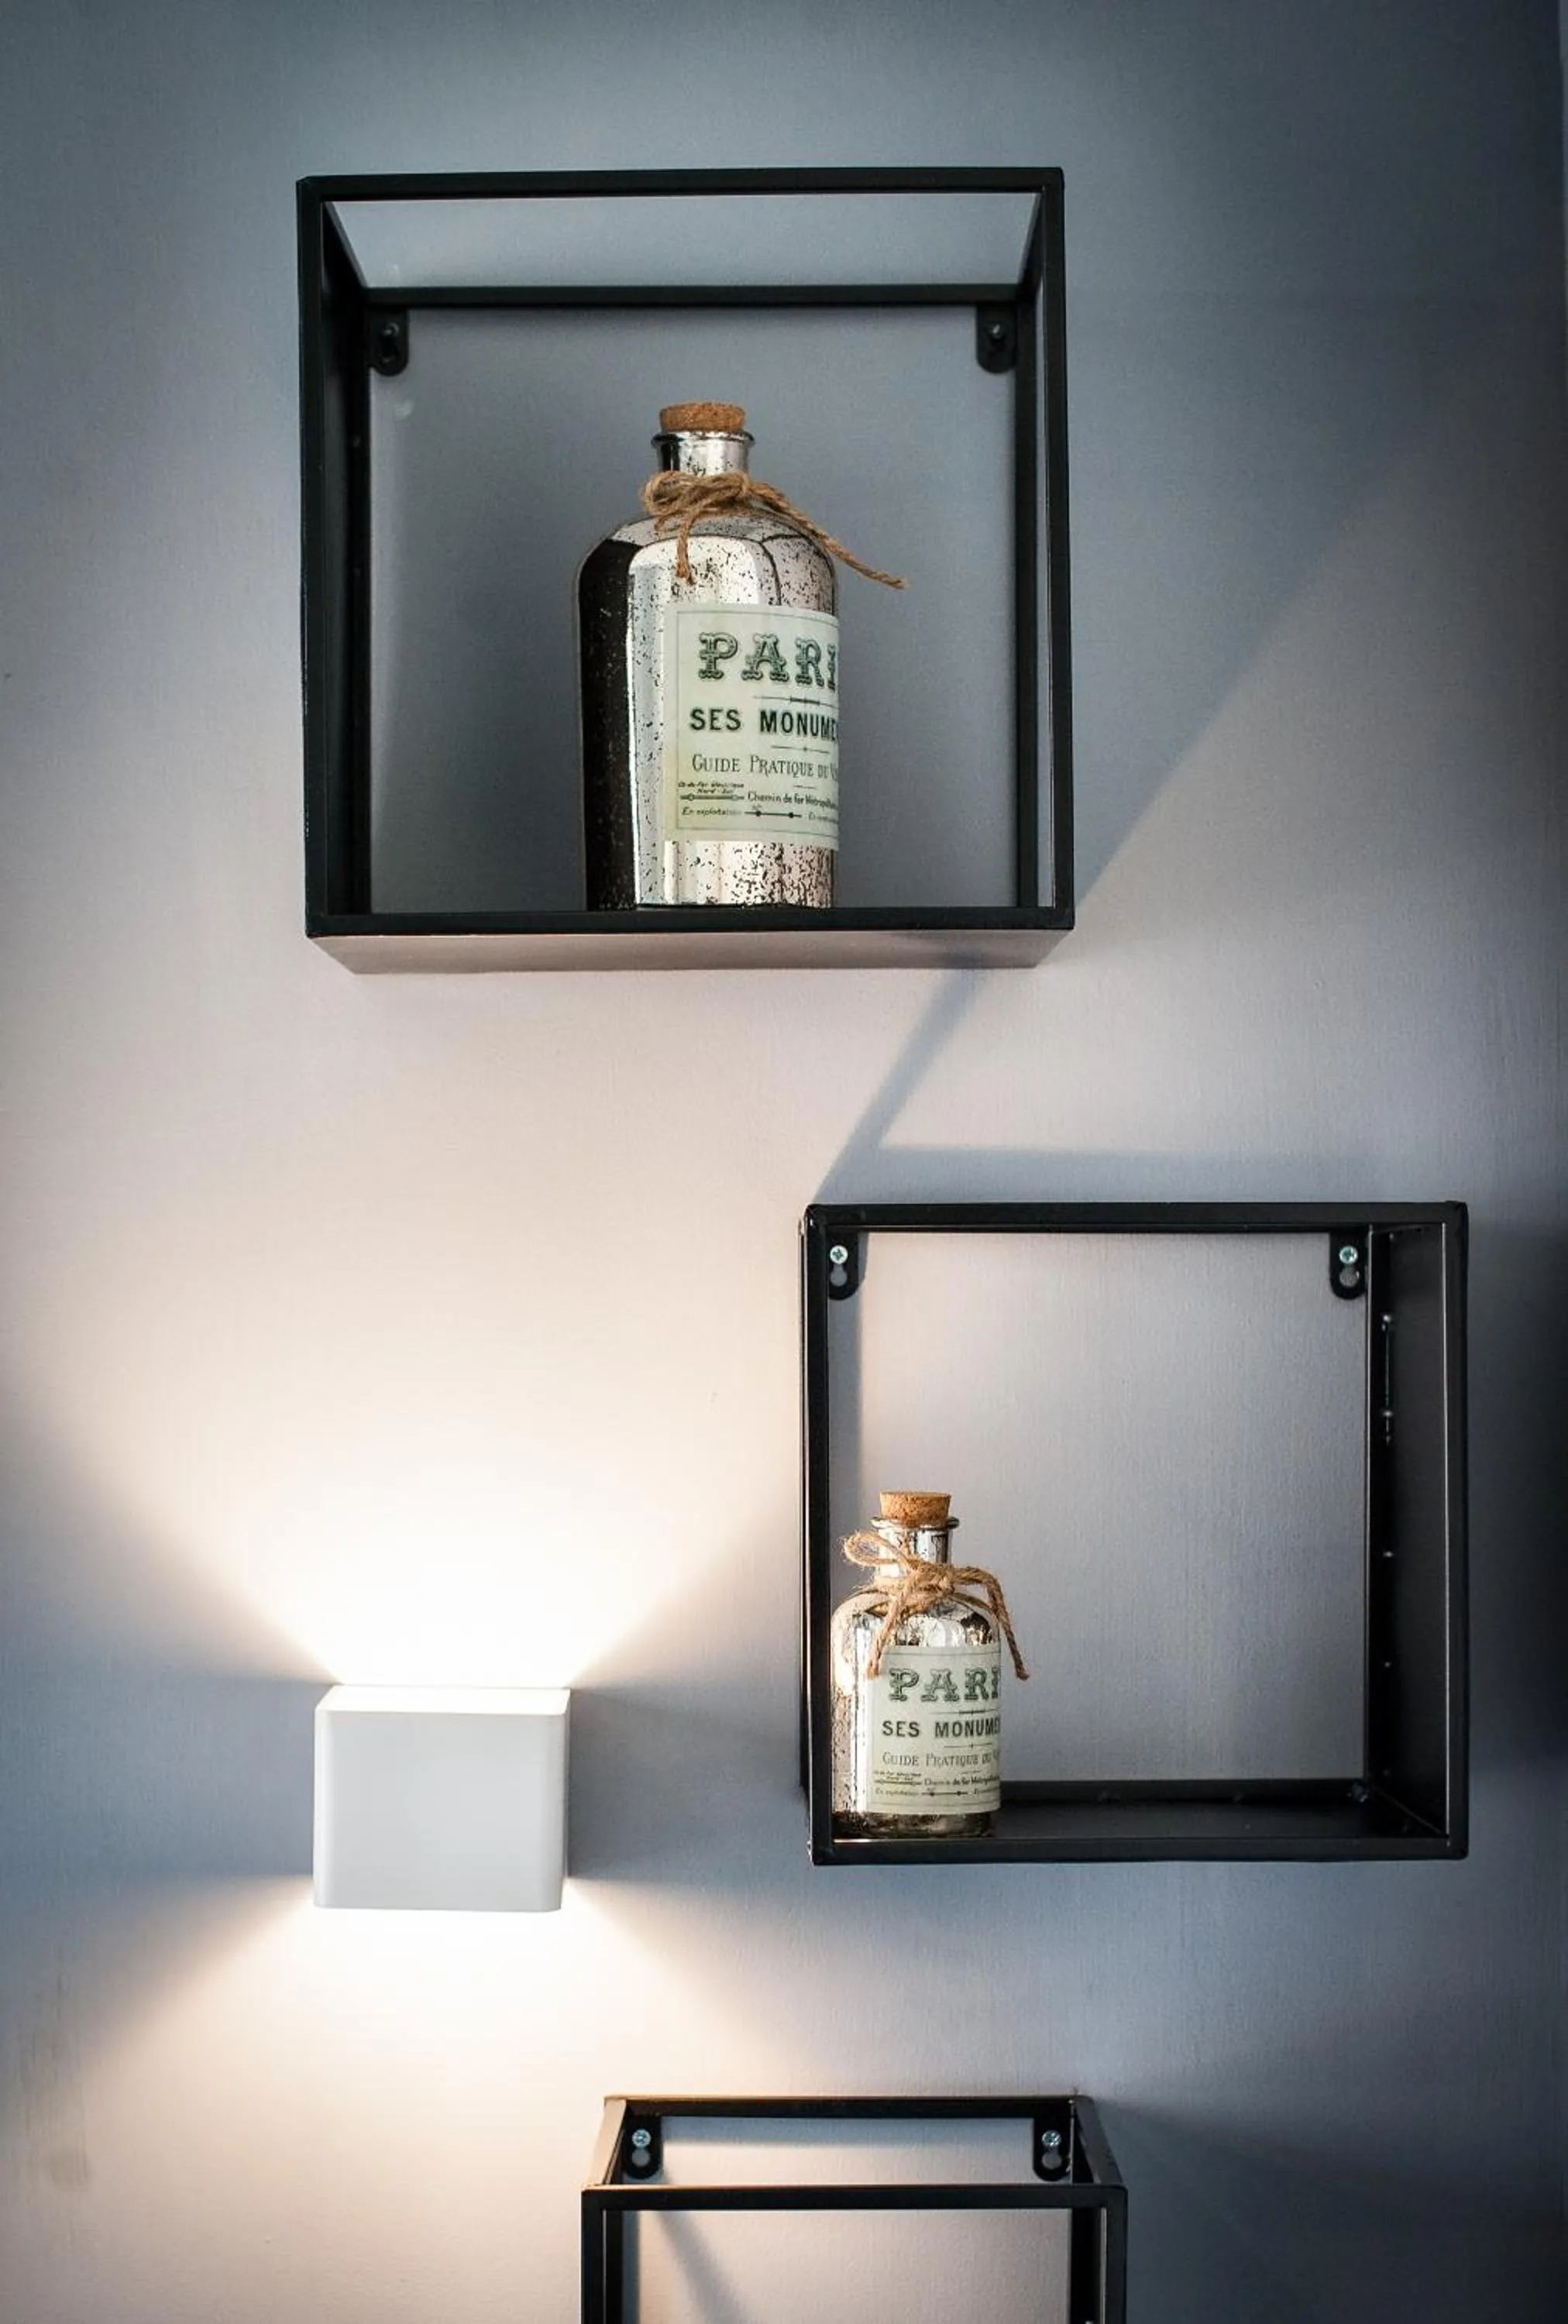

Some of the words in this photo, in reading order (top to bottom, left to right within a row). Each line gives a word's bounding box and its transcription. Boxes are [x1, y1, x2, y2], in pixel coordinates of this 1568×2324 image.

[689, 708, 742, 731] SES
[692, 754, 741, 773] GUIDE
[750, 755, 814, 779] PRATIQUE
[748, 790, 782, 803] Chemin
[783, 793, 793, 803] de
[882, 1720, 920, 1738] SES
[882, 1751, 920, 1767] GUIDE
